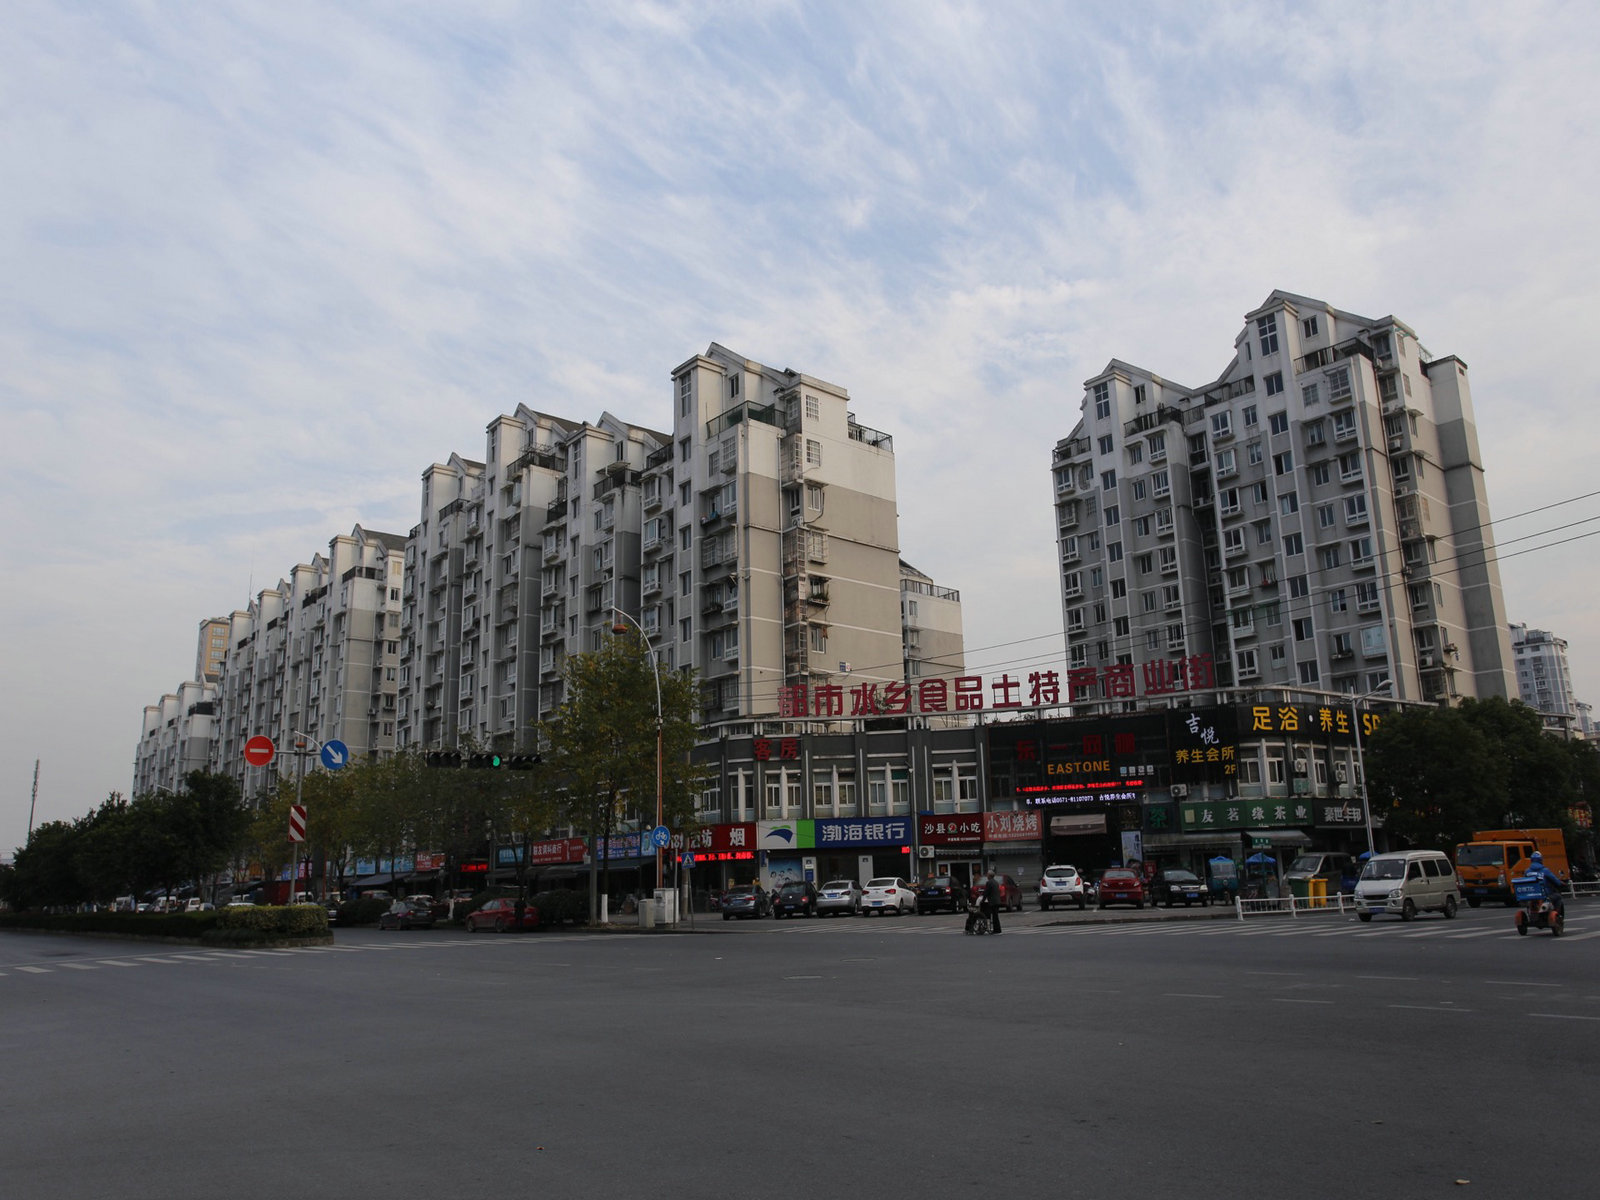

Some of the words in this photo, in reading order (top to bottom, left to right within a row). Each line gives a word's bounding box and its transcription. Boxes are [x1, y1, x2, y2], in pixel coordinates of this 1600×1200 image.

[754, 738, 797, 761] 客房
[1175, 746, 1235, 764] 养生会所
[1047, 760, 1111, 775] EASTONE
[1224, 764, 1236, 775] 2F
[1201, 805, 1307, 823] 友茗缘茶业
[821, 822, 906, 842] 渤海银行
[924, 822, 946, 835] 沙县
[959, 822, 981, 834] 小吃
[987, 814, 1038, 833] 小刘烧烤
[729, 827, 746, 847] 烟
